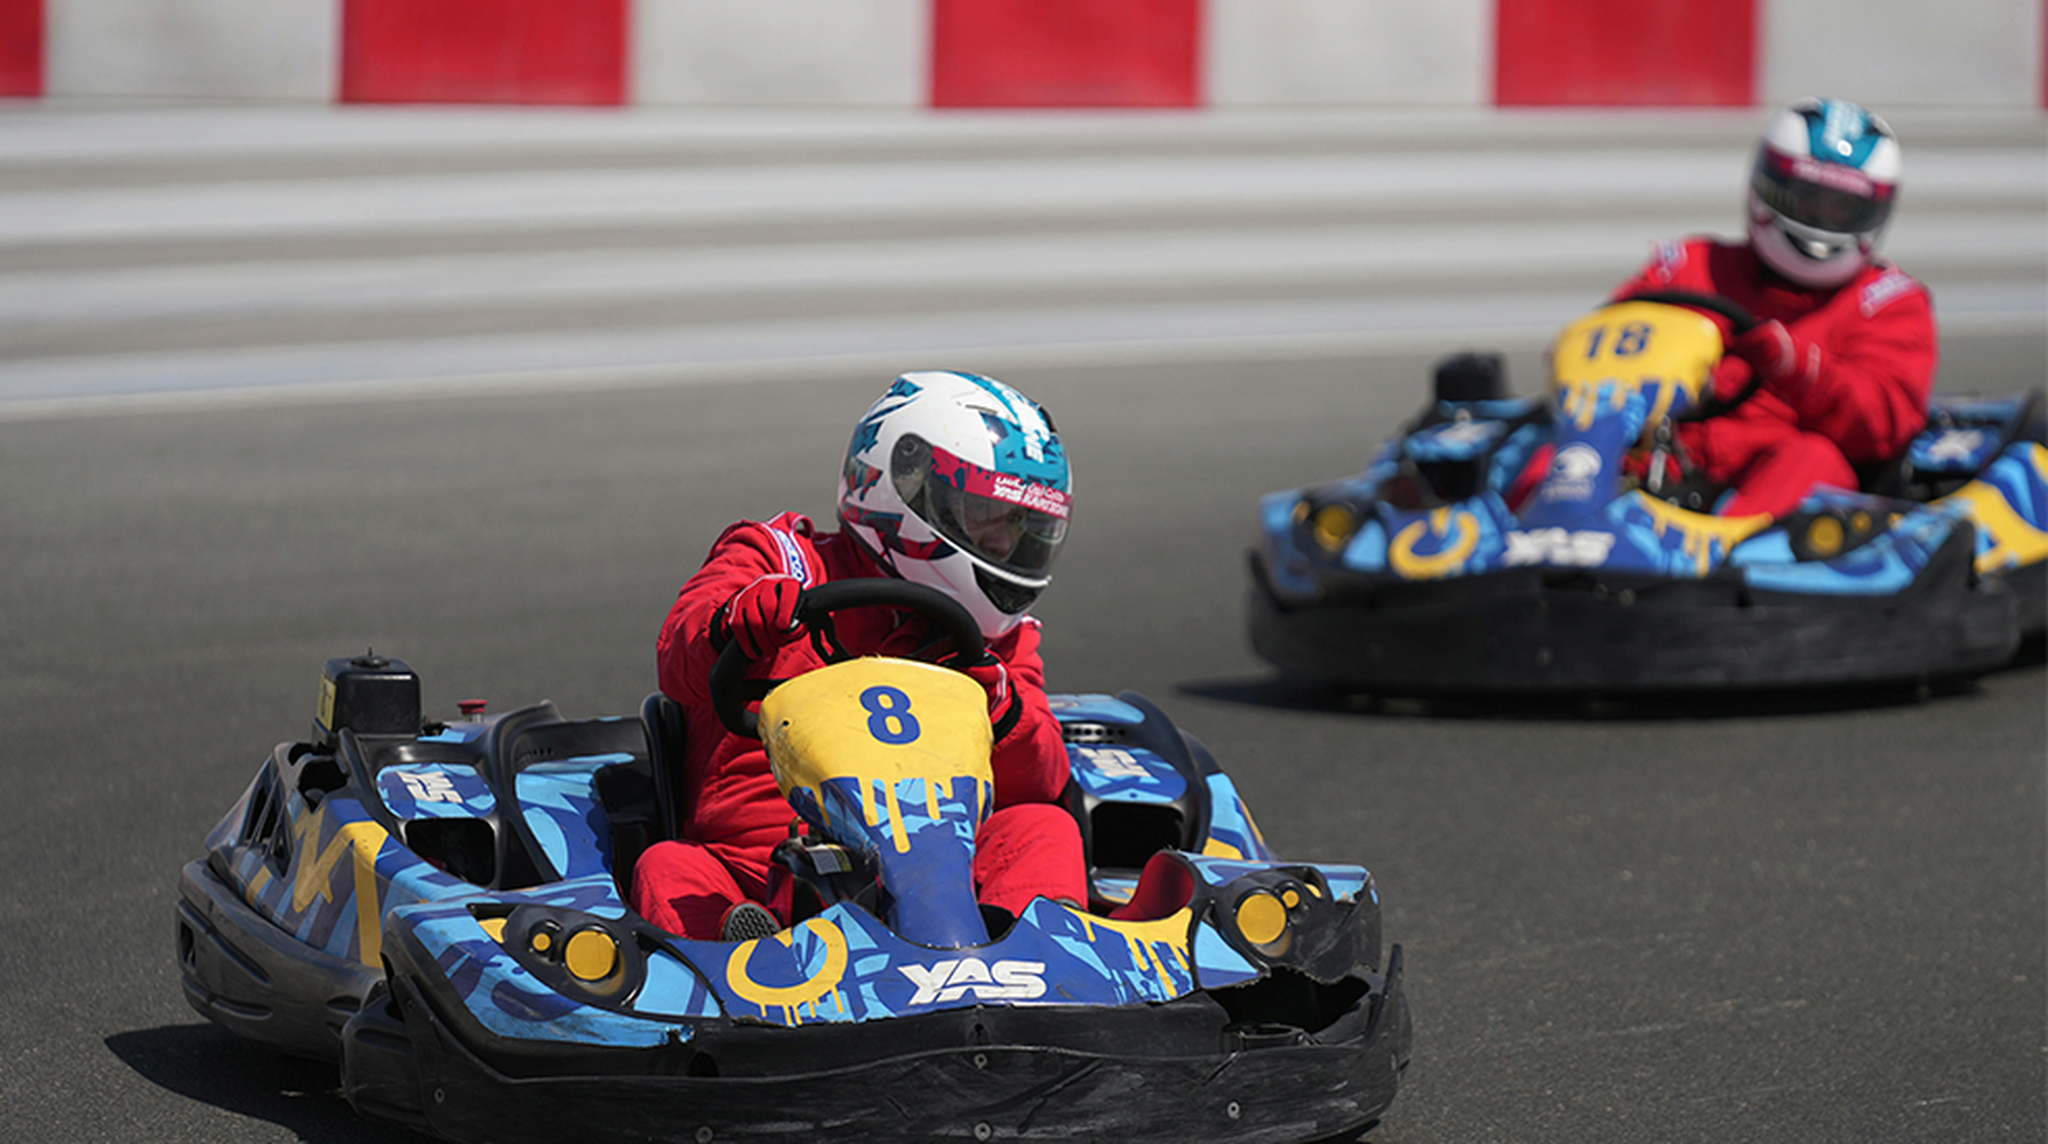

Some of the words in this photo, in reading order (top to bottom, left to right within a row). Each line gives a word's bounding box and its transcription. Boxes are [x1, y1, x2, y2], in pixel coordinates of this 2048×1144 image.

[1585, 321, 1656, 361] 18
[859, 685, 921, 745] 8
[897, 957, 1047, 1006] YAS
